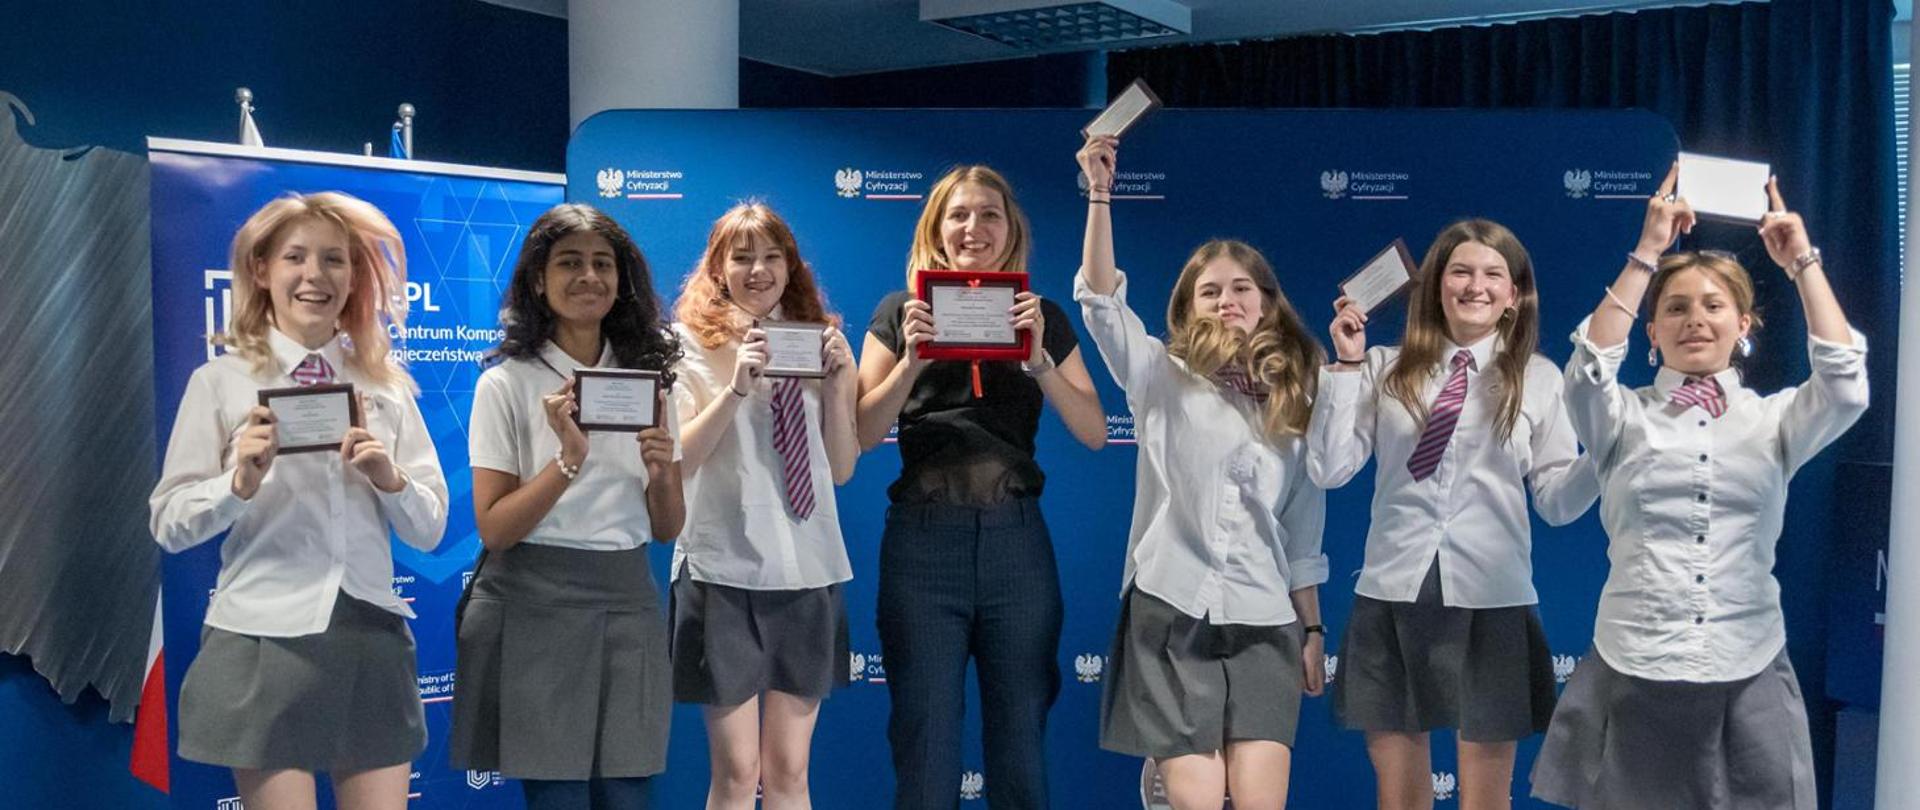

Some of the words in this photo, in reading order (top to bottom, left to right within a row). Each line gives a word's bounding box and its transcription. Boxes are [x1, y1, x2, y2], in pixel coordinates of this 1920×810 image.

[626, 170, 683, 179] Ministerstwo
[865, 170, 922, 179] Ministerstwo
[1115, 171, 1165, 181] inisterstwo
[1351, 172, 1408, 181] Ministerstwo
[1594, 171, 1652, 180] Ministerstwo
[626, 181, 669, 191] Cyfryzacji
[865, 181, 908, 192] Cyfryzacji
[1114, 182, 1151, 193] yfryzacji
[1351, 182, 1394, 193] Cyfryzacji
[1594, 181, 1637, 192] Cyfryzacji
[387, 323, 453, 340] Centrum
[456, 324, 507, 343] Kompe
[1106, 415, 1134, 424] Minist
